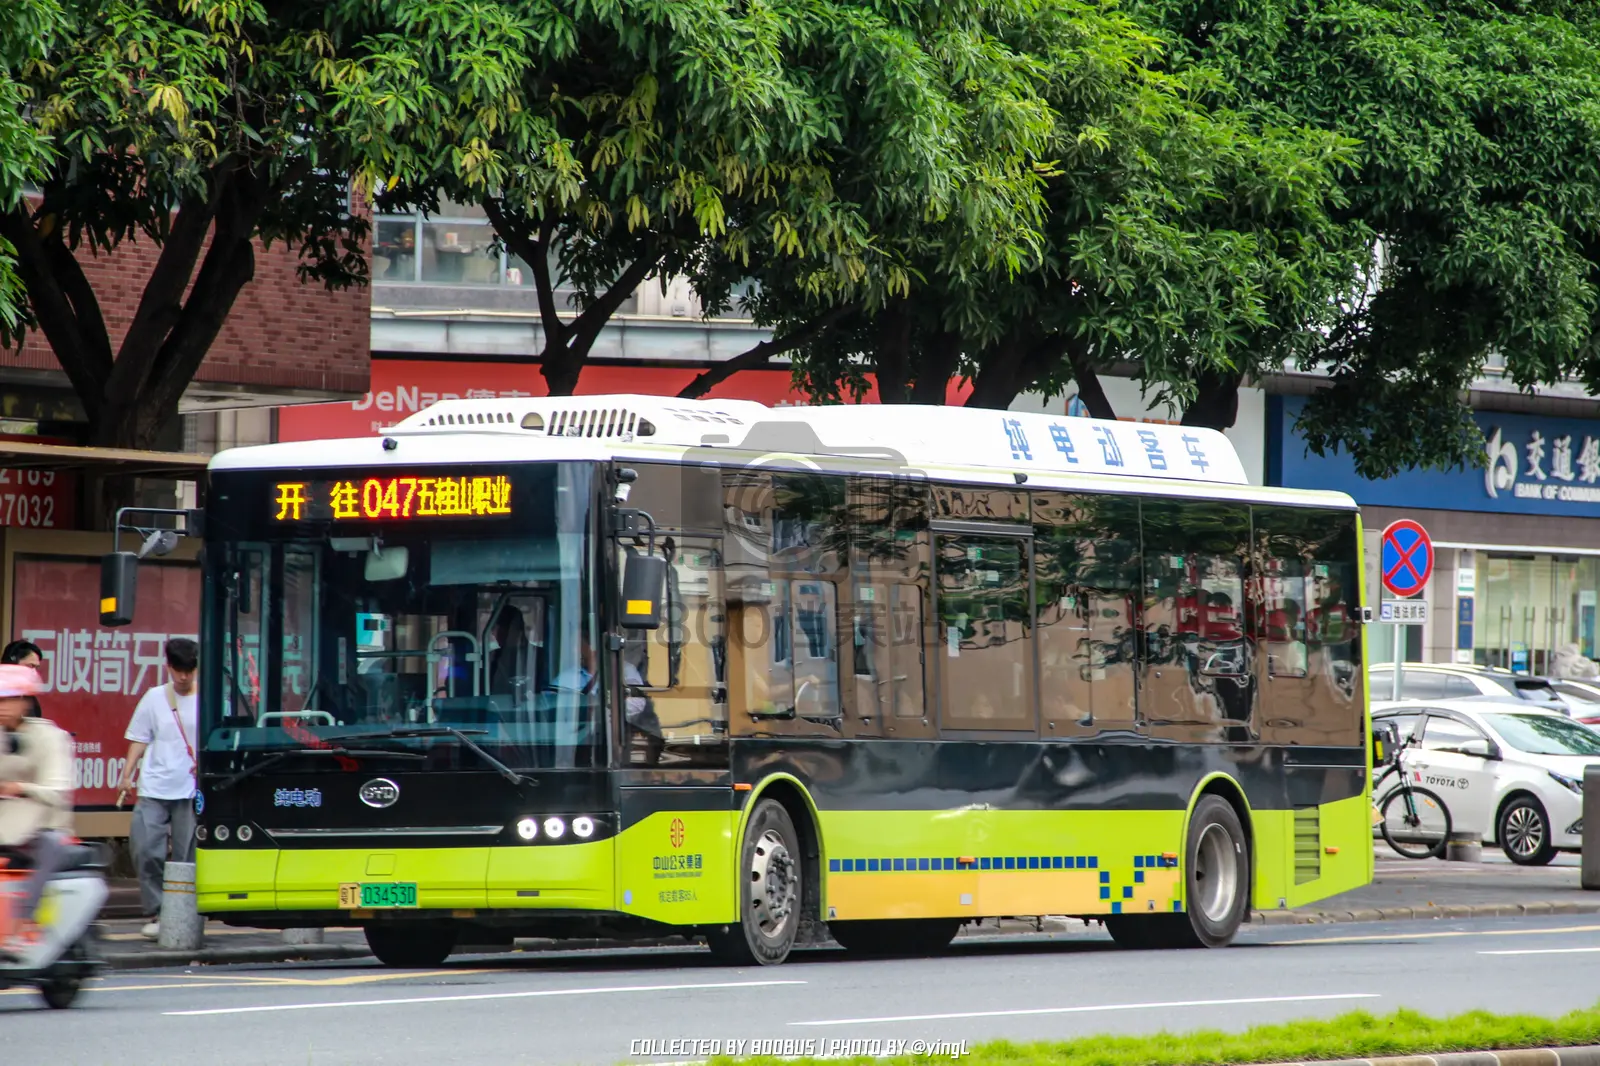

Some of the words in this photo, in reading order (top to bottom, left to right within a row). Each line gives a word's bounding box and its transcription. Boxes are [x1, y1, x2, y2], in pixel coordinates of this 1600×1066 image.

[1002, 417, 1210, 473] 纯电动客车
[1514, 482, 1542, 498] BANK
[1542, 484, 1558, 499] OF
[0, 493, 54, 527] 7032
[1425, 776, 1456, 788] TOYOTA
[274, 787, 322, 808] 纯电动
